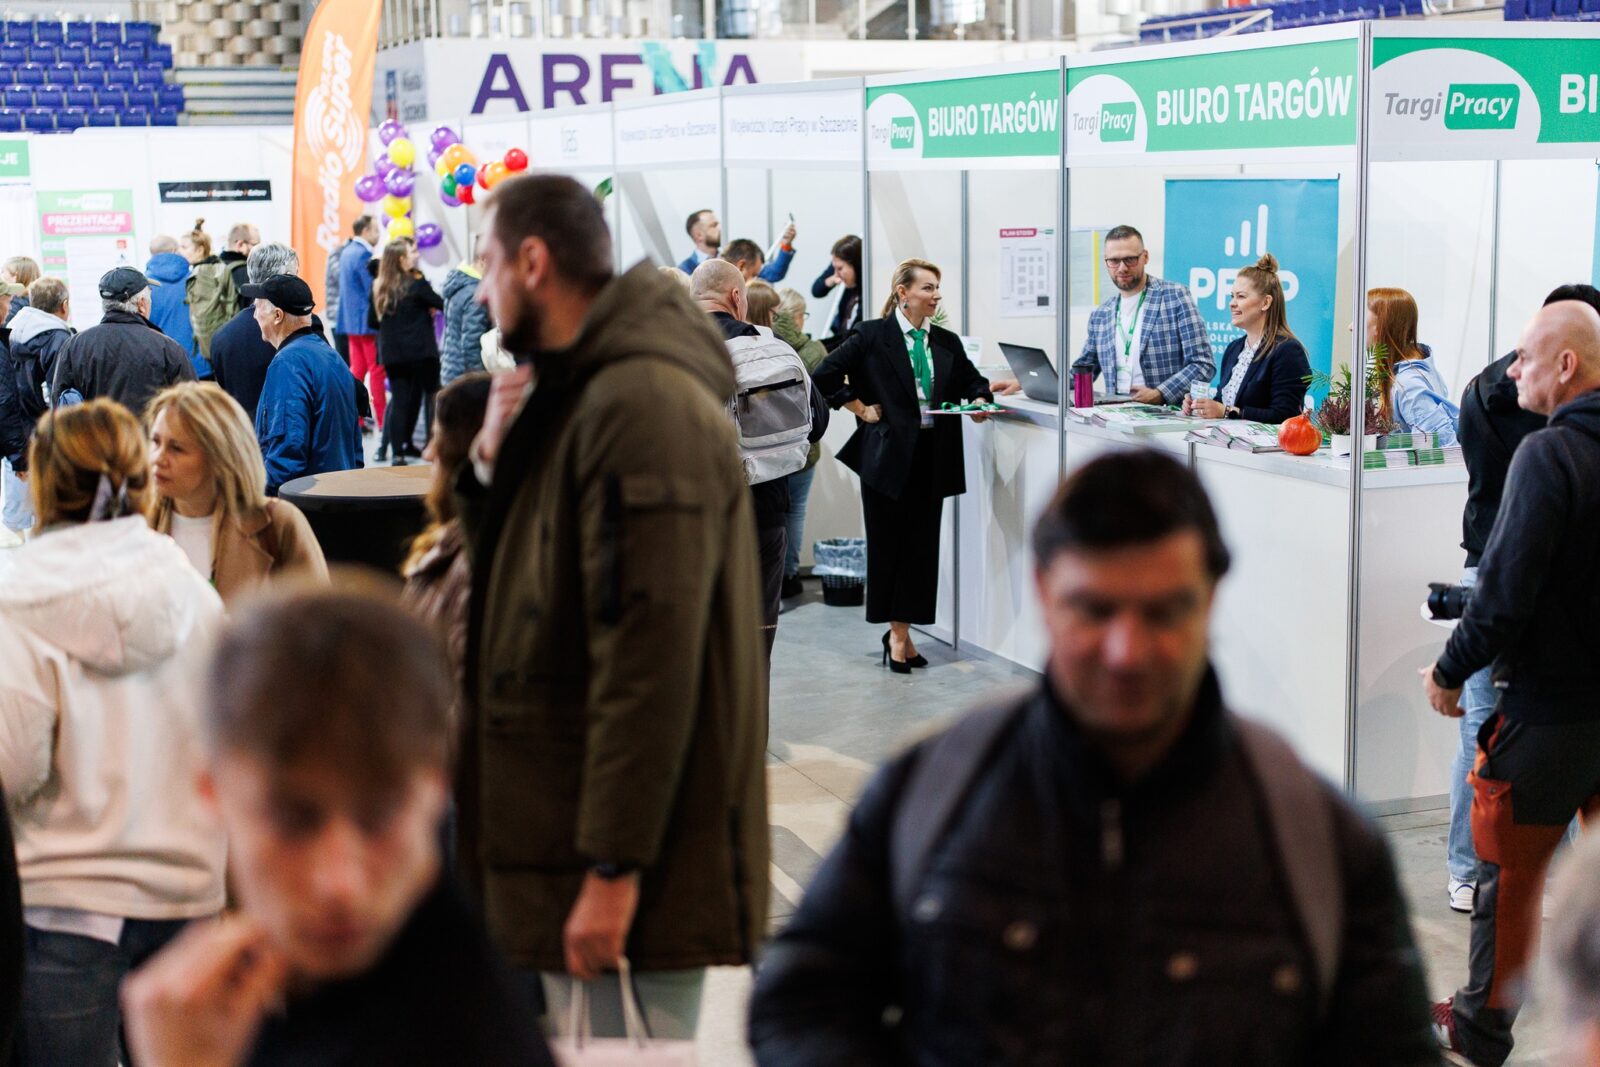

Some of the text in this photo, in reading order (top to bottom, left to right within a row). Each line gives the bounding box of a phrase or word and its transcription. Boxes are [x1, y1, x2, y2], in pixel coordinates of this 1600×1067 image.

[323, 34, 353, 148] Super
[1156, 66, 1353, 126] BIURO TARGÓW
[1385, 92, 1514, 121] Targi Pracy
[871, 123, 914, 143] Targi Pracy
[928, 91, 1058, 137] BIURO TARGÓW
[1073, 111, 1134, 135] Targi Pracy
[316, 151, 343, 250] Radio
[1190, 267, 1299, 310] PFP
